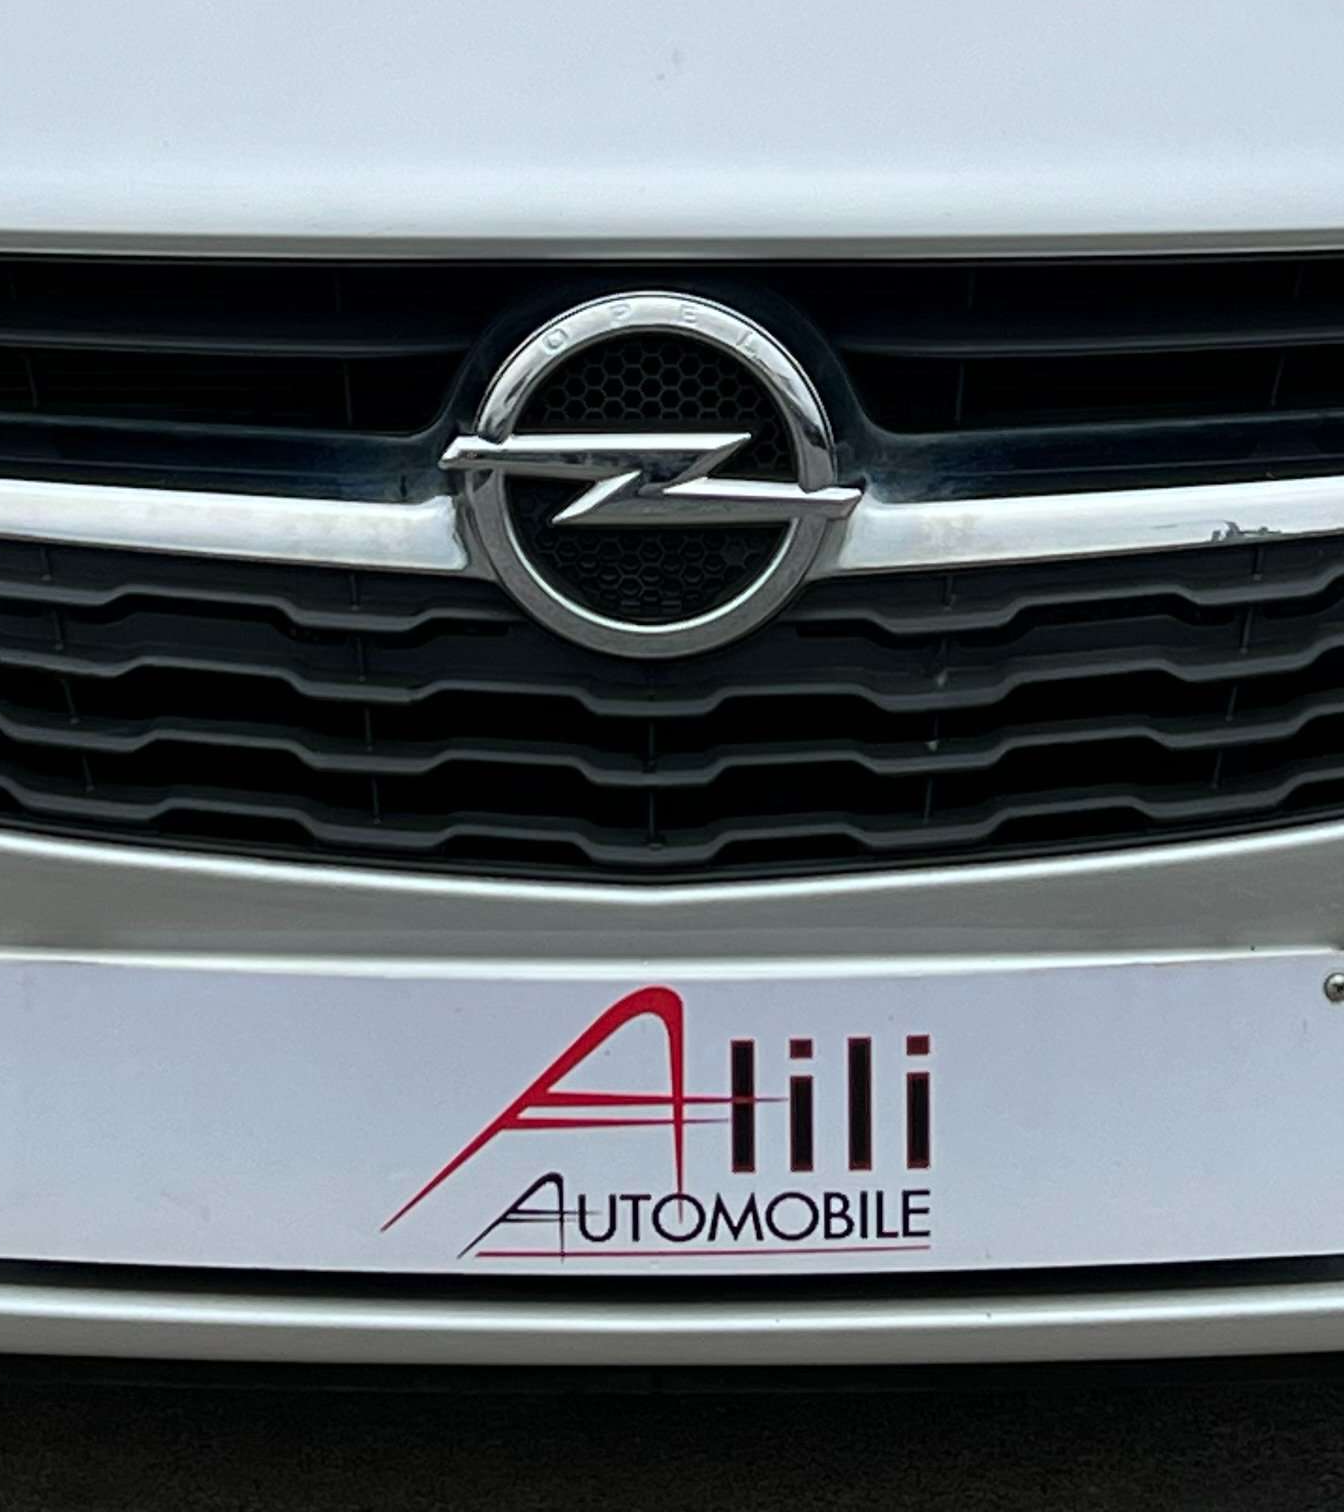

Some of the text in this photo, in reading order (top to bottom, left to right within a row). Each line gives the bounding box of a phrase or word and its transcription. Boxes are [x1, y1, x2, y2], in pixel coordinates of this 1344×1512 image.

[540, 301, 763, 364] OPEL
[380, 985, 932, 1231] Alili
[457, 1171, 932, 1263] AUTOMOBILE
